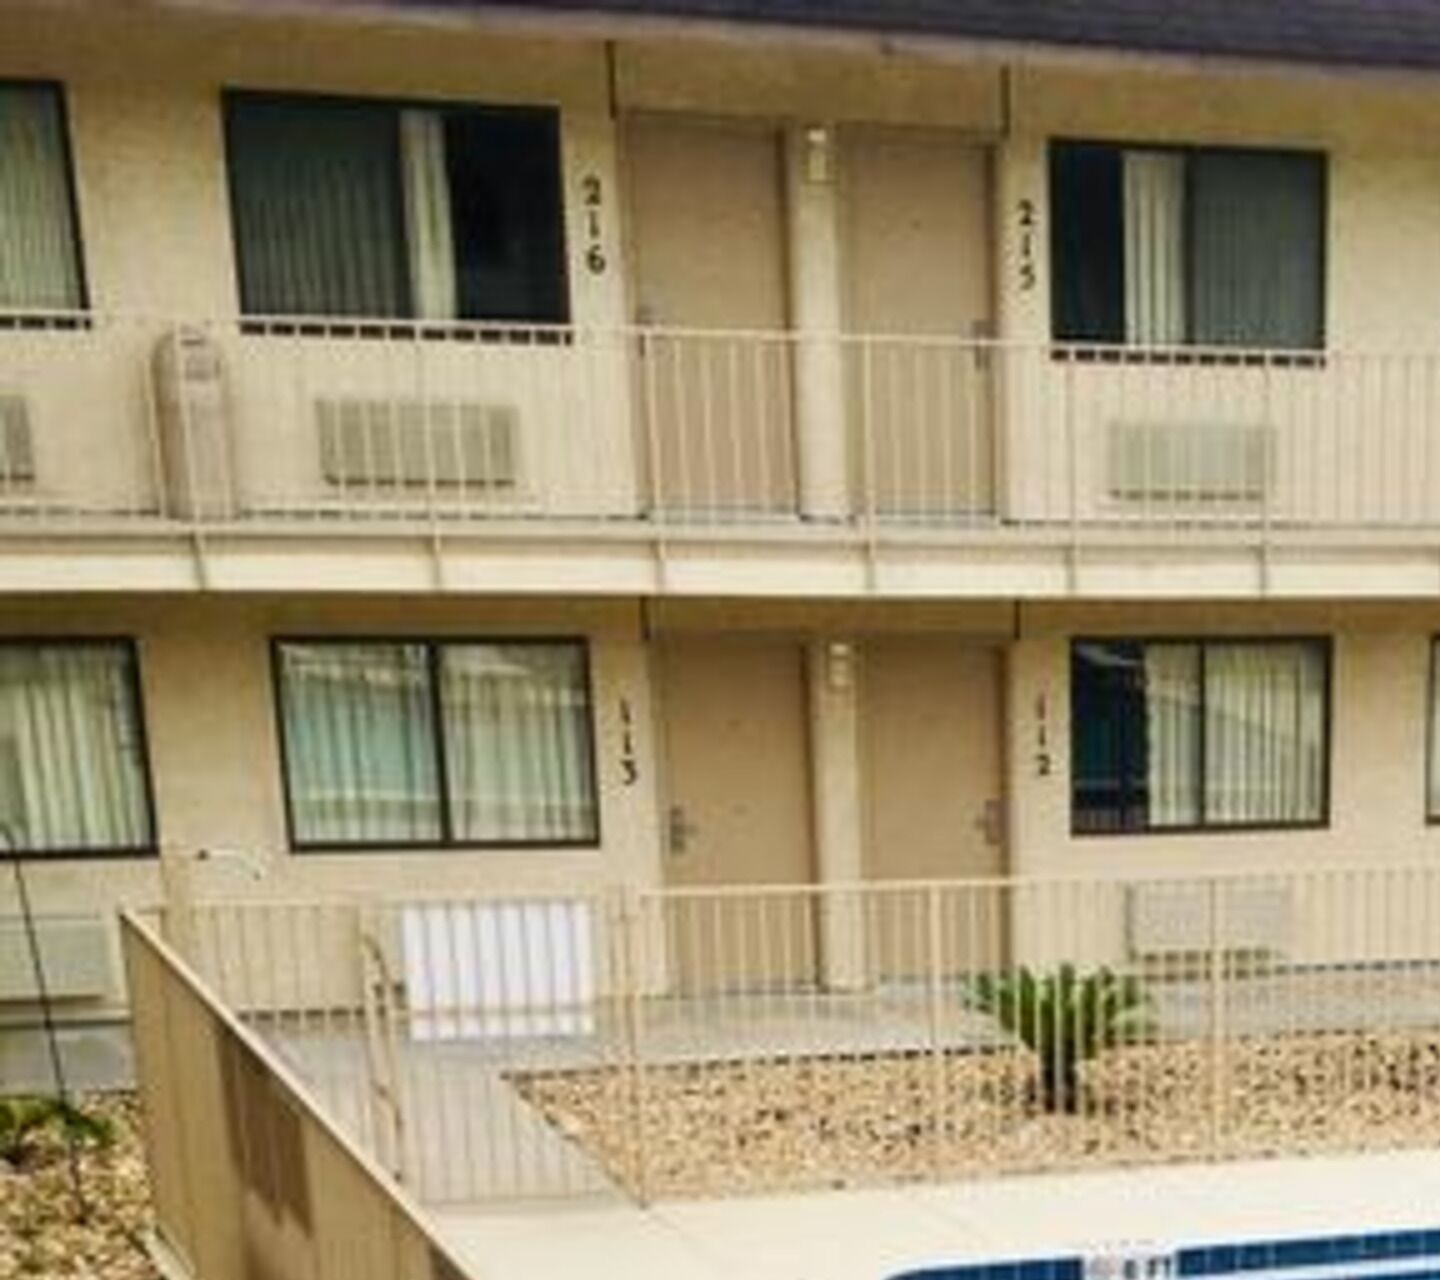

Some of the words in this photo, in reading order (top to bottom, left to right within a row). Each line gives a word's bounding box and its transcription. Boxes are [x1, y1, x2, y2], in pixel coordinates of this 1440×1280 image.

[582, 176, 607, 275] 216
[1018, 198, 1037, 291] 215
[619, 698, 638, 786] 113
[1034, 692, 1051, 777] 112
